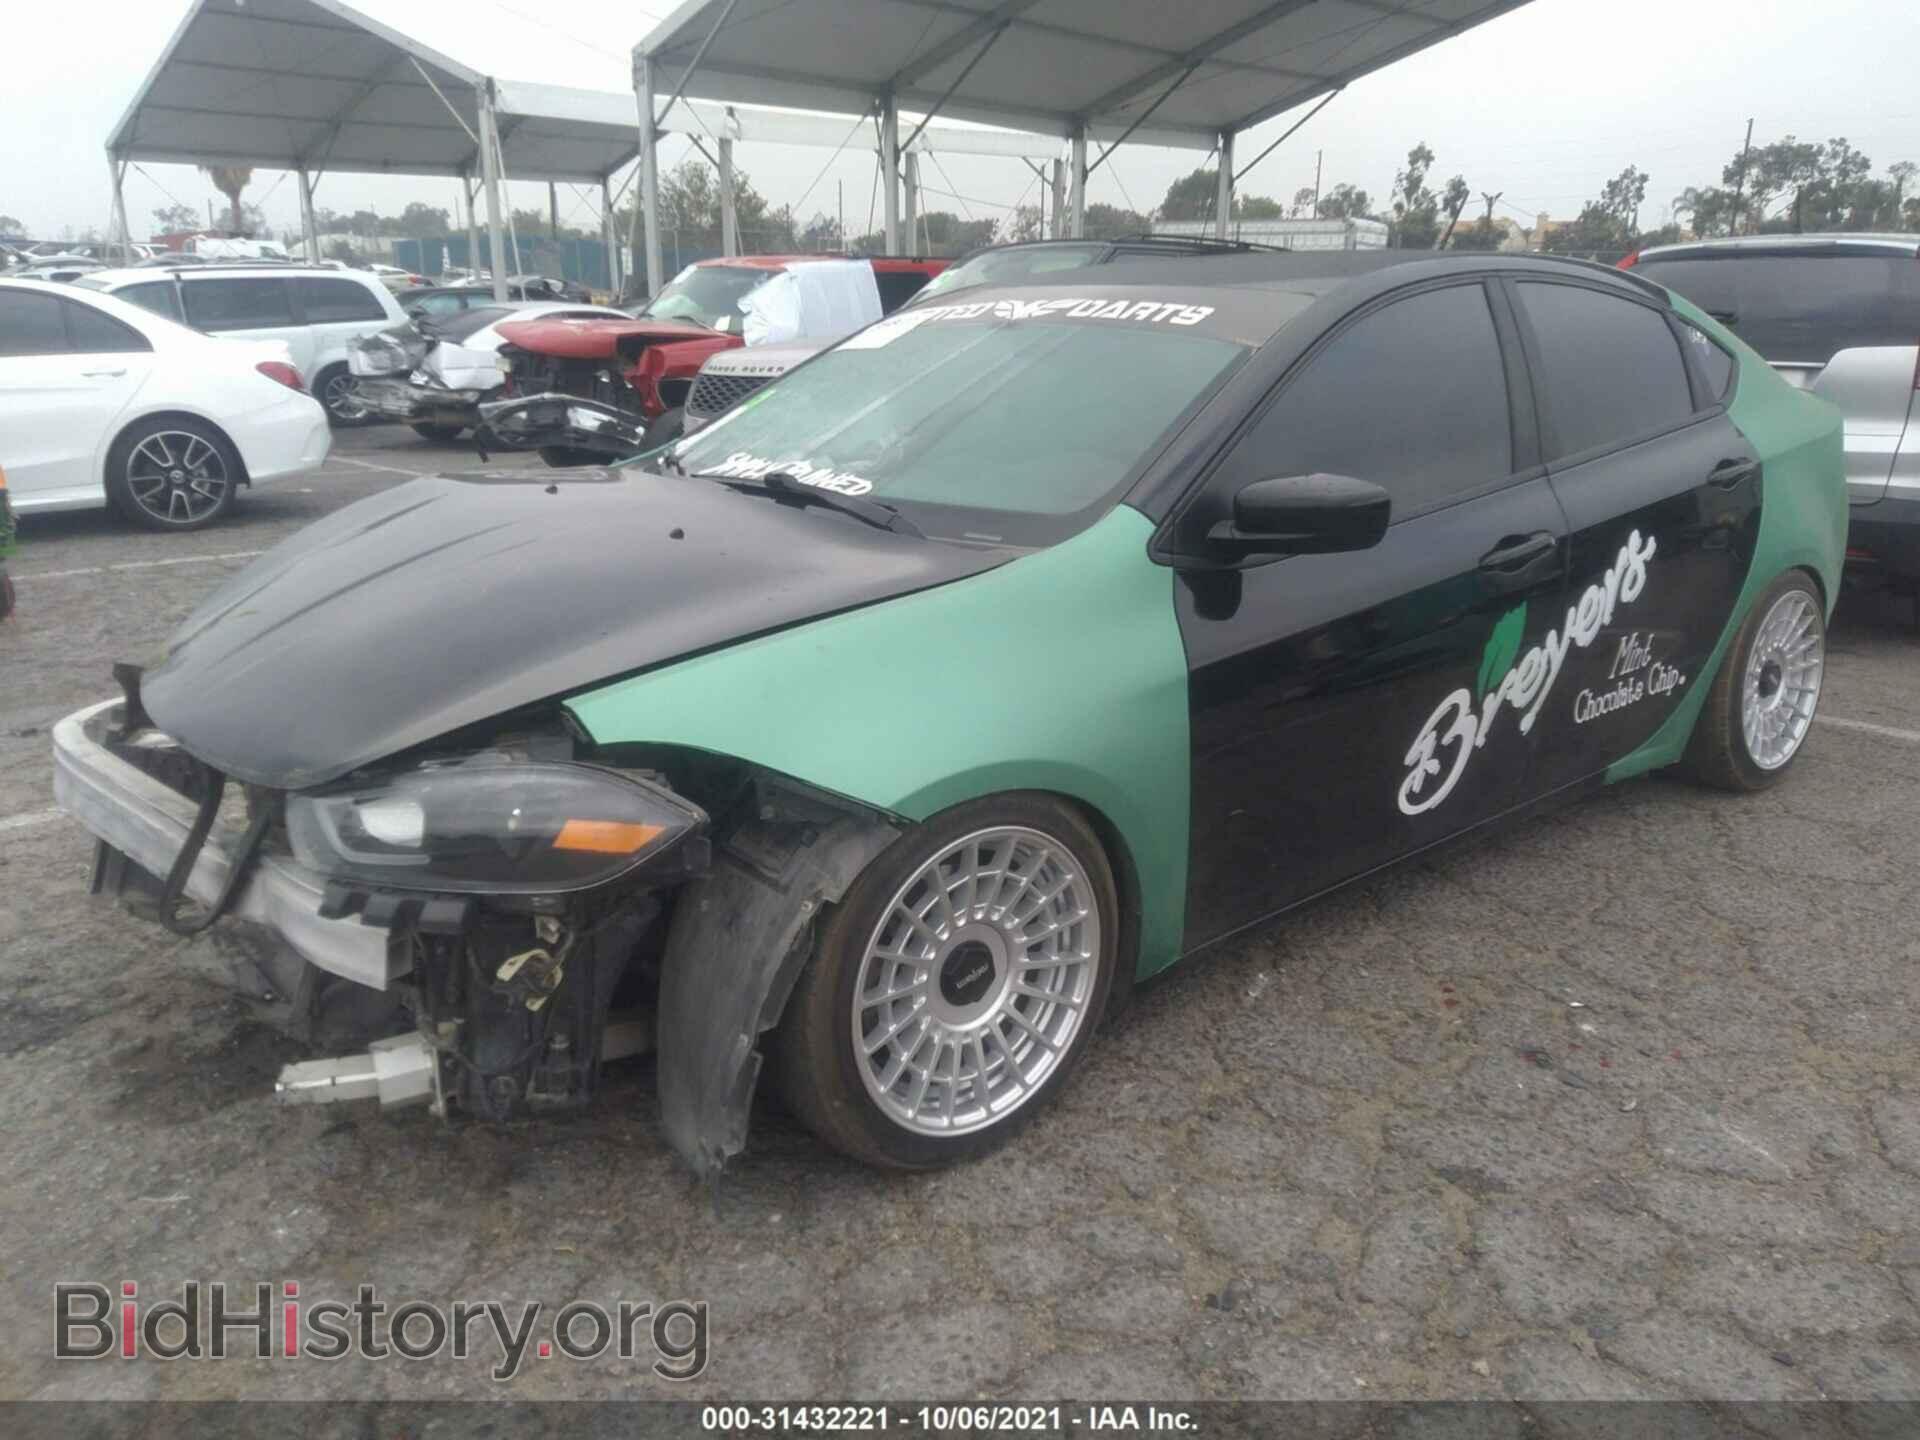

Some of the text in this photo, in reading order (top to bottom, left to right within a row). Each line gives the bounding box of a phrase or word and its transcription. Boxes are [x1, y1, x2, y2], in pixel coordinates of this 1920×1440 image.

[1065, 299, 1216, 325] DARTS
[742, 365, 785, 374] ROVER
[1398, 528, 1657, 815] Breyers
[1608, 632, 1655, 680] Mint
[1574, 677, 1644, 724] Chocolate
